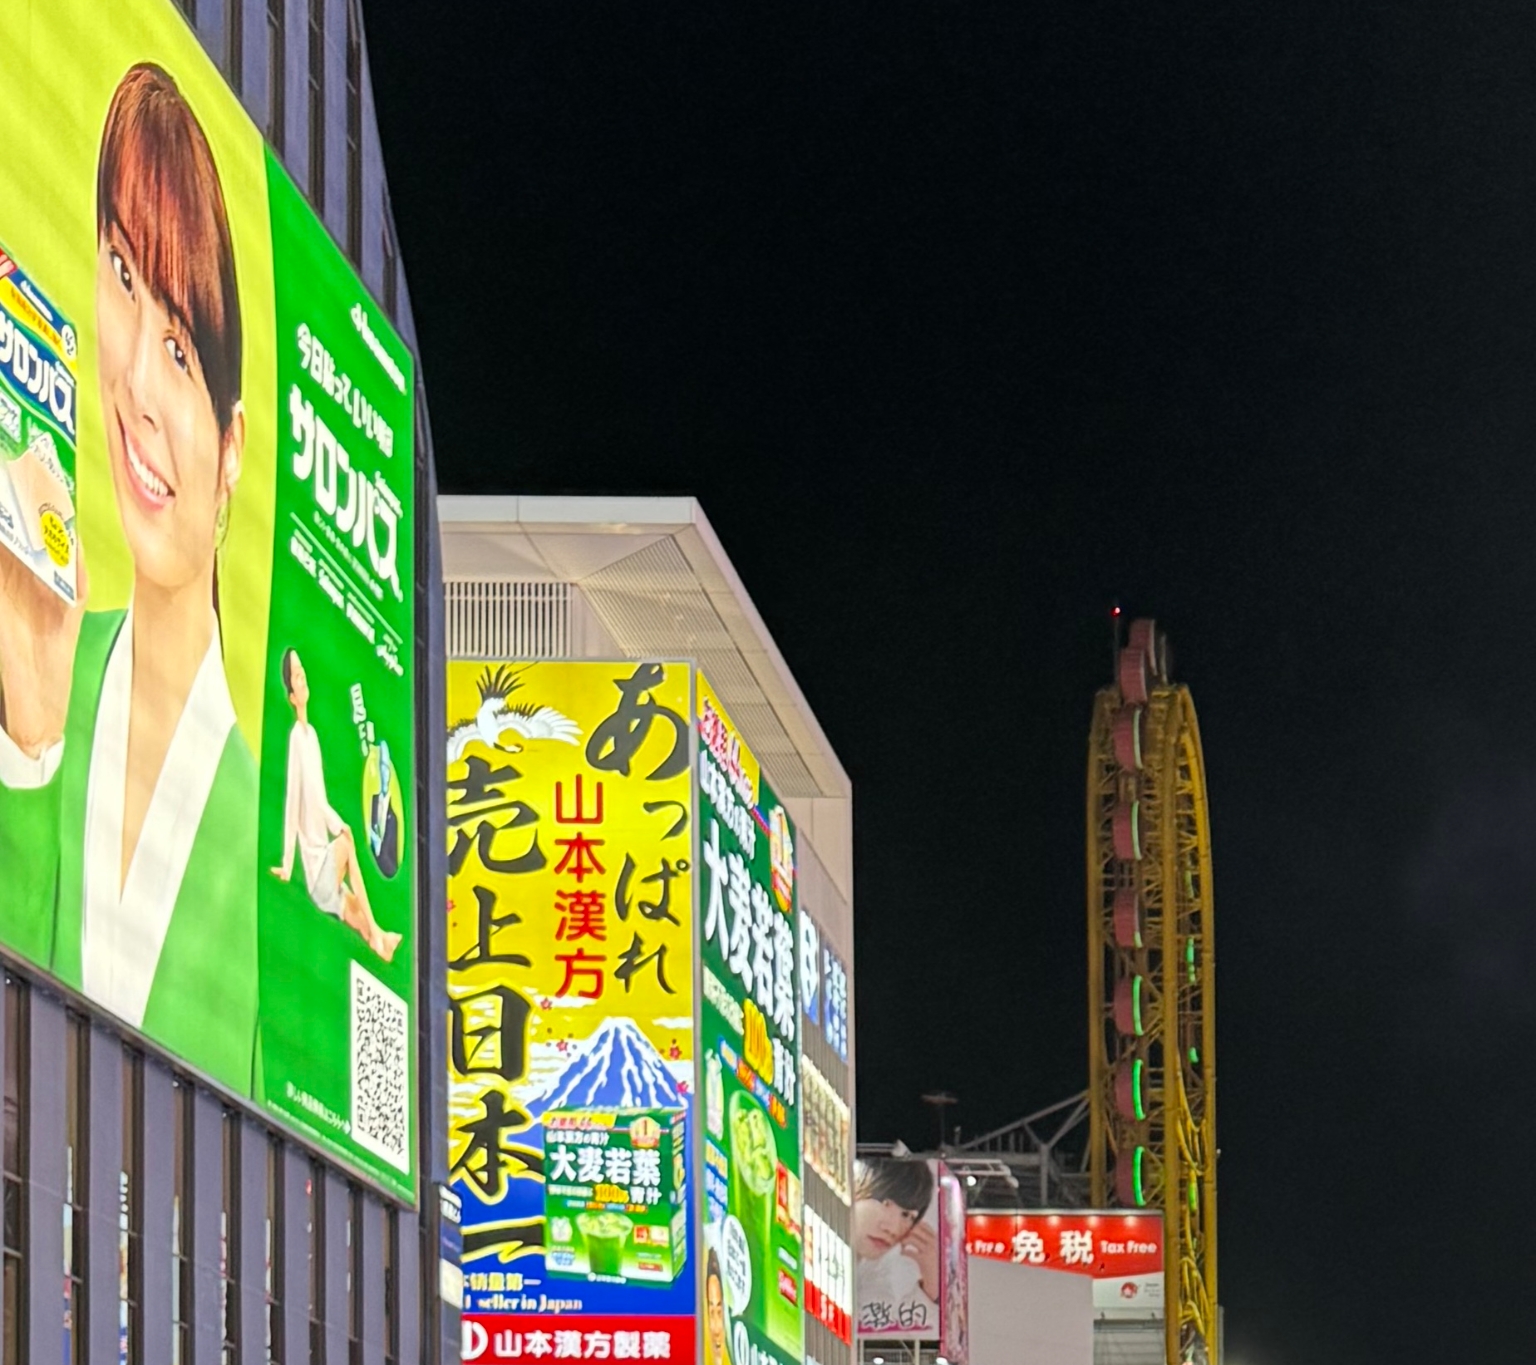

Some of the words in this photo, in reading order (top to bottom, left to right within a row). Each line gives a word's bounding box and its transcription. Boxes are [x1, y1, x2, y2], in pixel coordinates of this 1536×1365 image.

[289, 384, 404, 602] サロンパス
[586, 662, 690, 994] あっぱれ
[553, 773, 606, 1000] 山本漢方
[703, 818, 794, 1042] 大麦若葉
[447, 755, 546, 1262] 売上日本一
[549, 1144, 661, 1186] 大麦若葉
[630, 1186, 663, 1205] 青汁
[1011, 1230, 1094, 1264] 免税
[1101, 1240, 1125, 1254] Tax
[1127, 1240, 1158, 1254] Free
[521, 1294, 537, 1310] in
[538, 1294, 583, 1314] Japan
[493, 1329, 671, 1359] 山本漢方製薬
